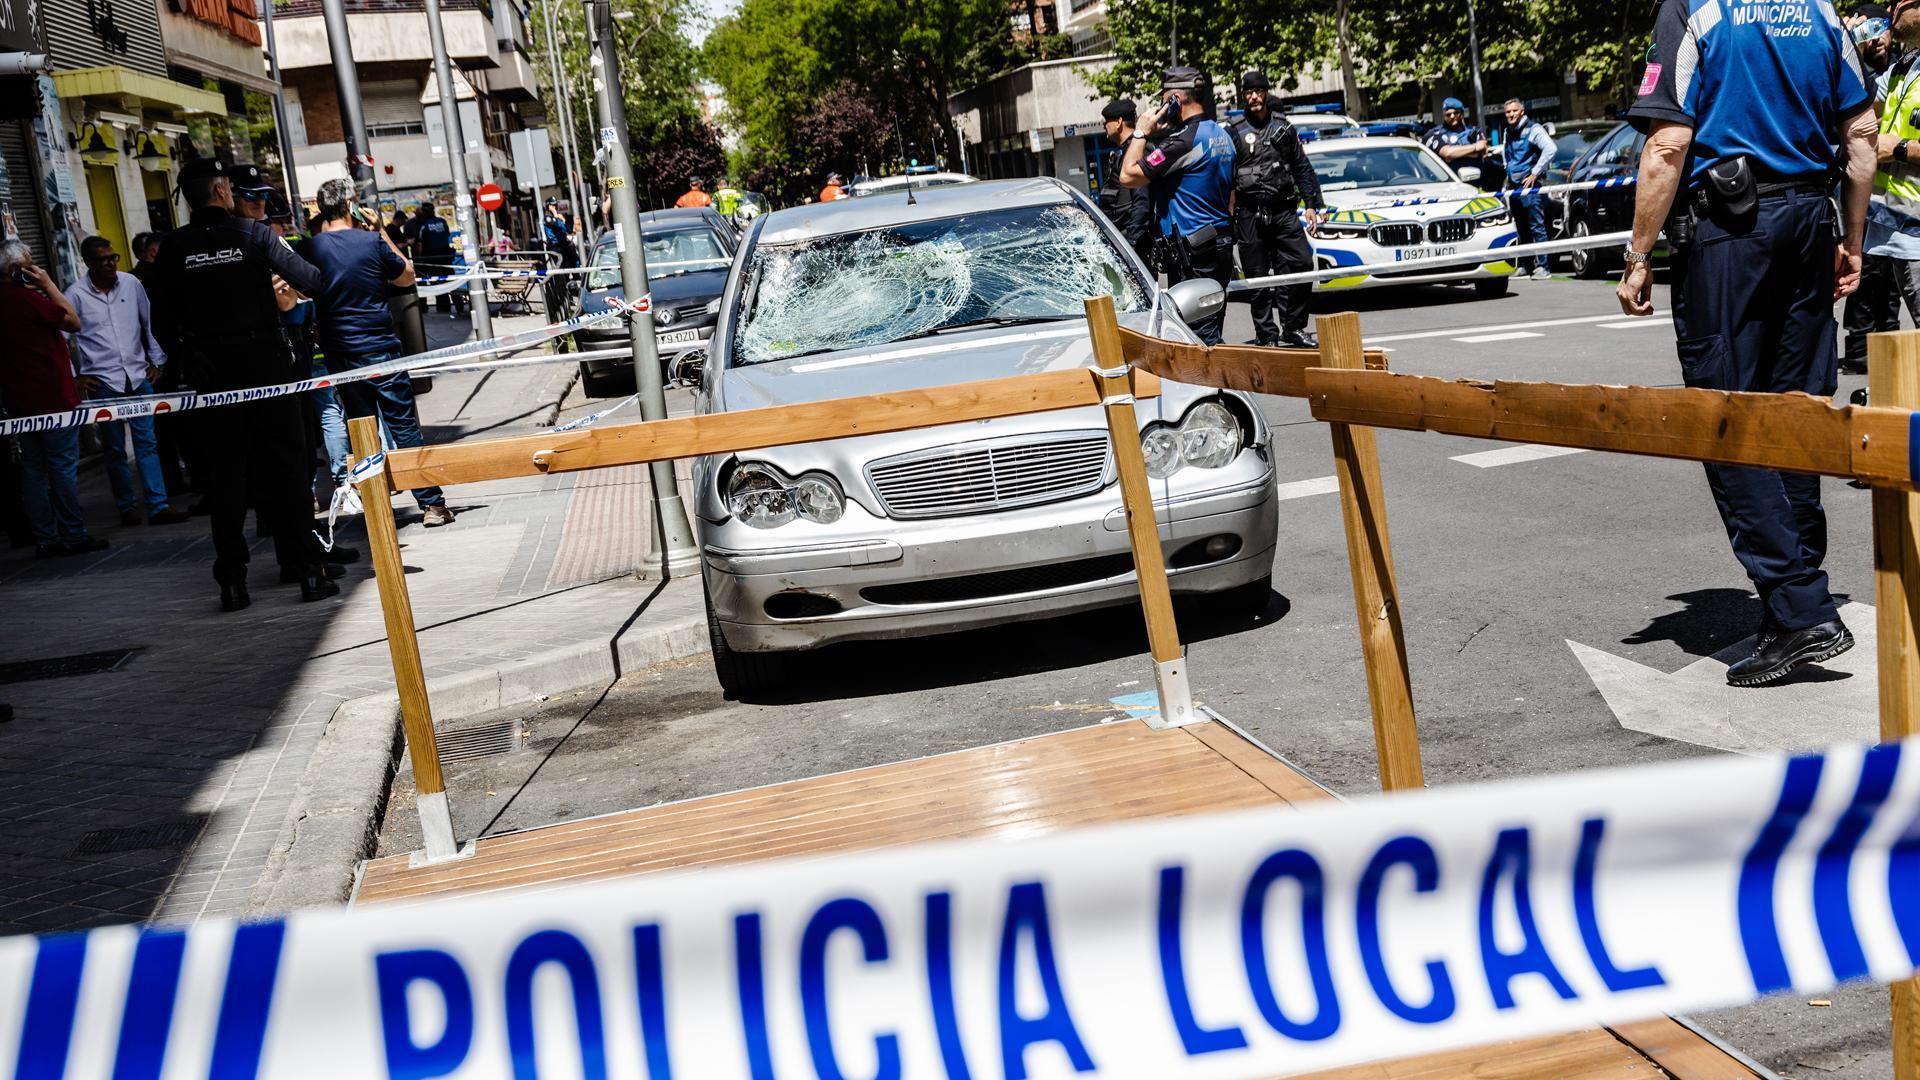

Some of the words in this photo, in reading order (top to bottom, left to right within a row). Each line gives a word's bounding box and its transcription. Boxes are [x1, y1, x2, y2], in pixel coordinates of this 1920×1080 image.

[1733, 5, 1812, 25] MUNICIPAL
[1403, 248, 1431, 260] 0971
[1157, 817, 1668, 1056] LOCAL
